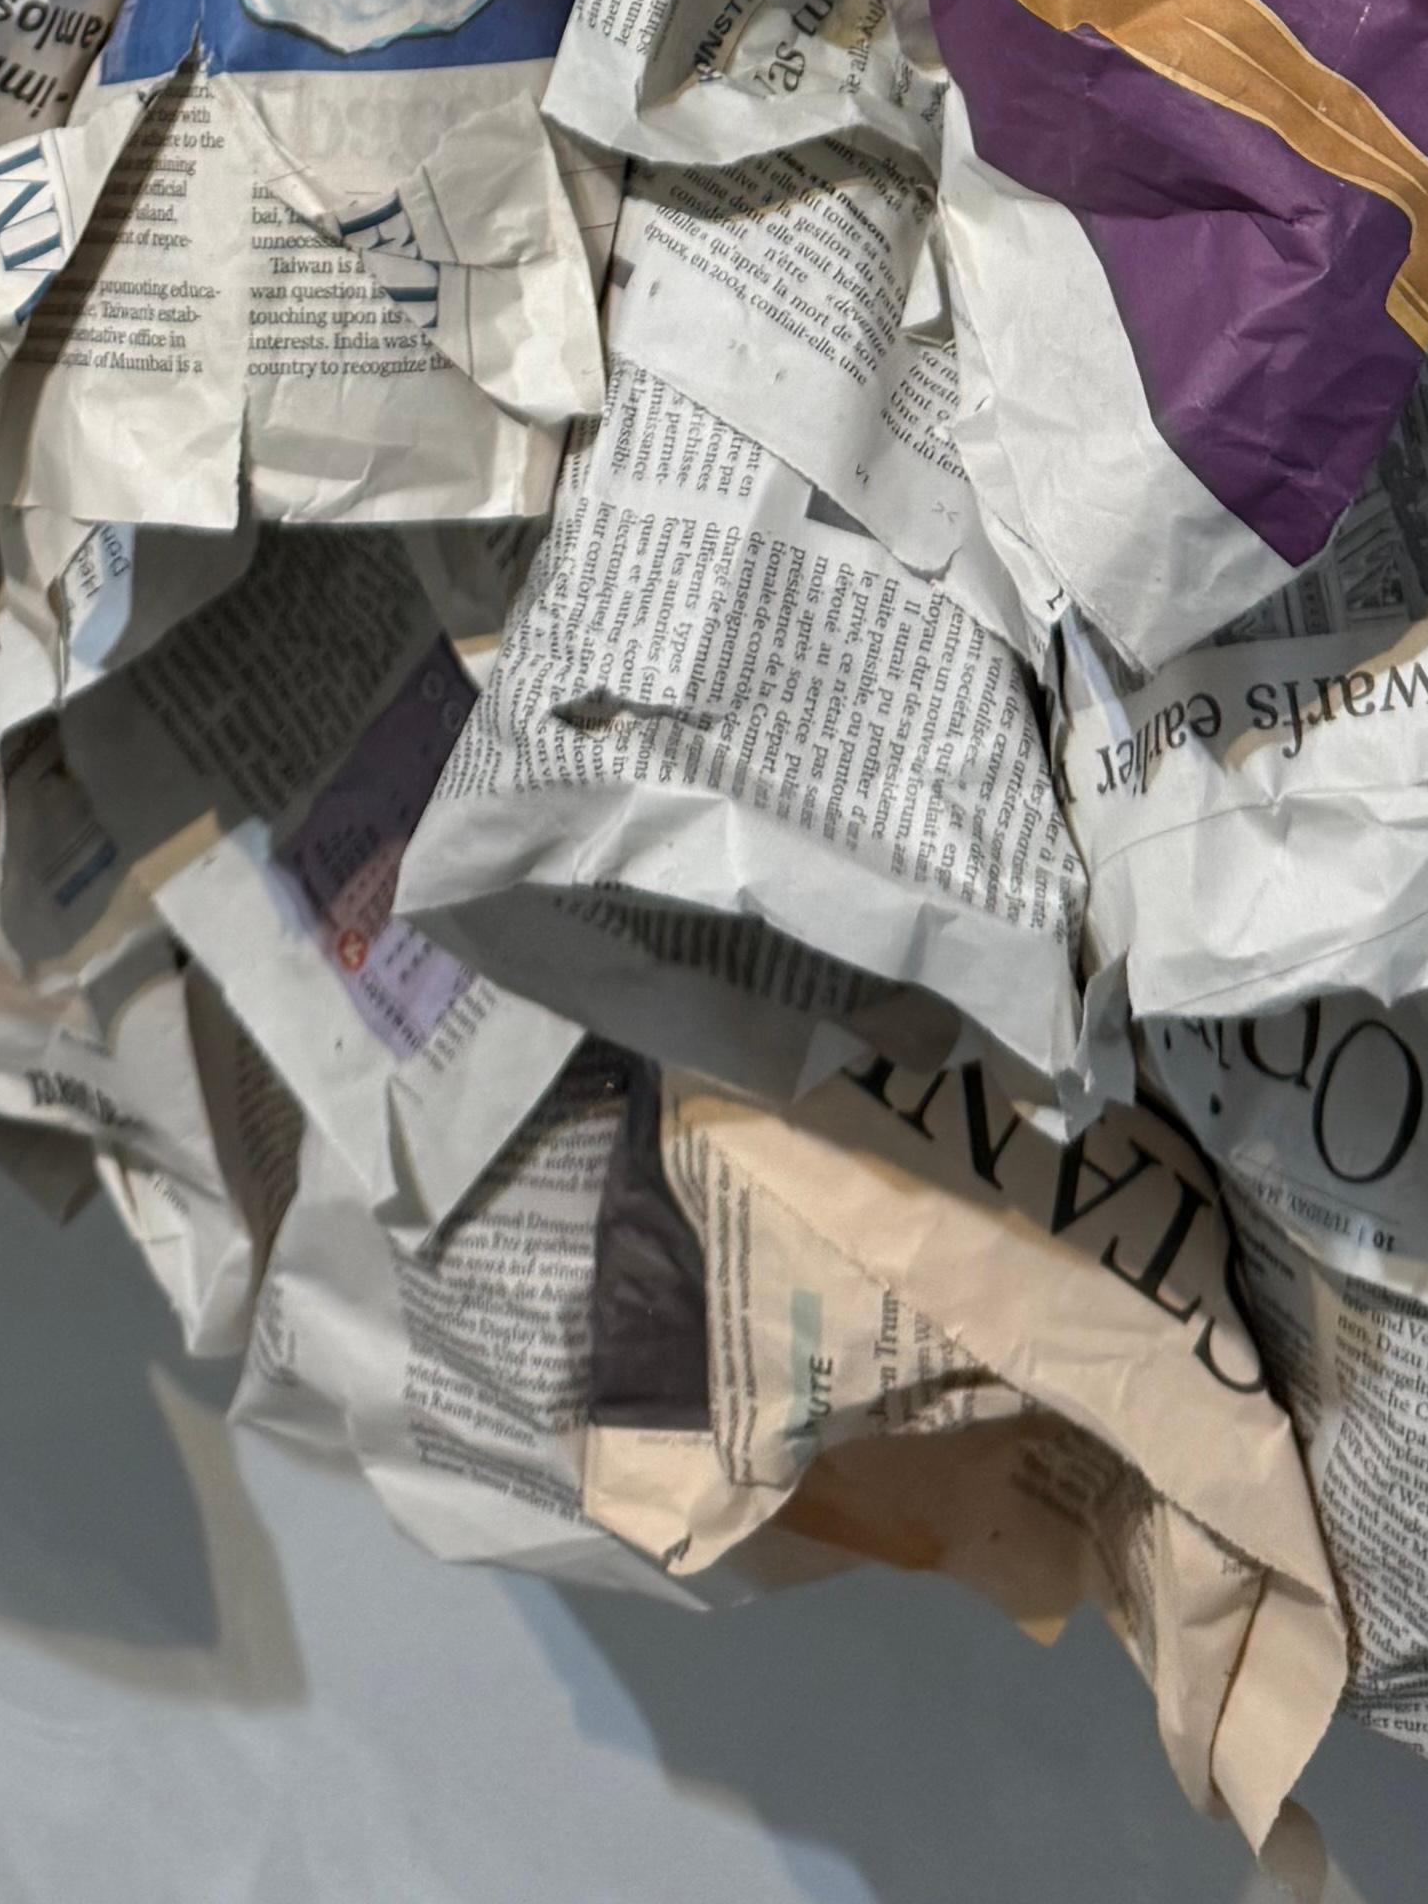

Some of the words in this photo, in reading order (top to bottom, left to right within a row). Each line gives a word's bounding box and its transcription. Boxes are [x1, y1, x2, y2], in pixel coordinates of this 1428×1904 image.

[268, 255, 335, 276] Taiwan
[336, 255, 354, 276] is
[289, 281, 369, 304] question
[247, 305, 329, 330] touching
[330, 309, 379, 331] upon
[332, 331, 382, 353] India
[246, 359, 319, 381] country
[340, 354, 428, 379] recognize
